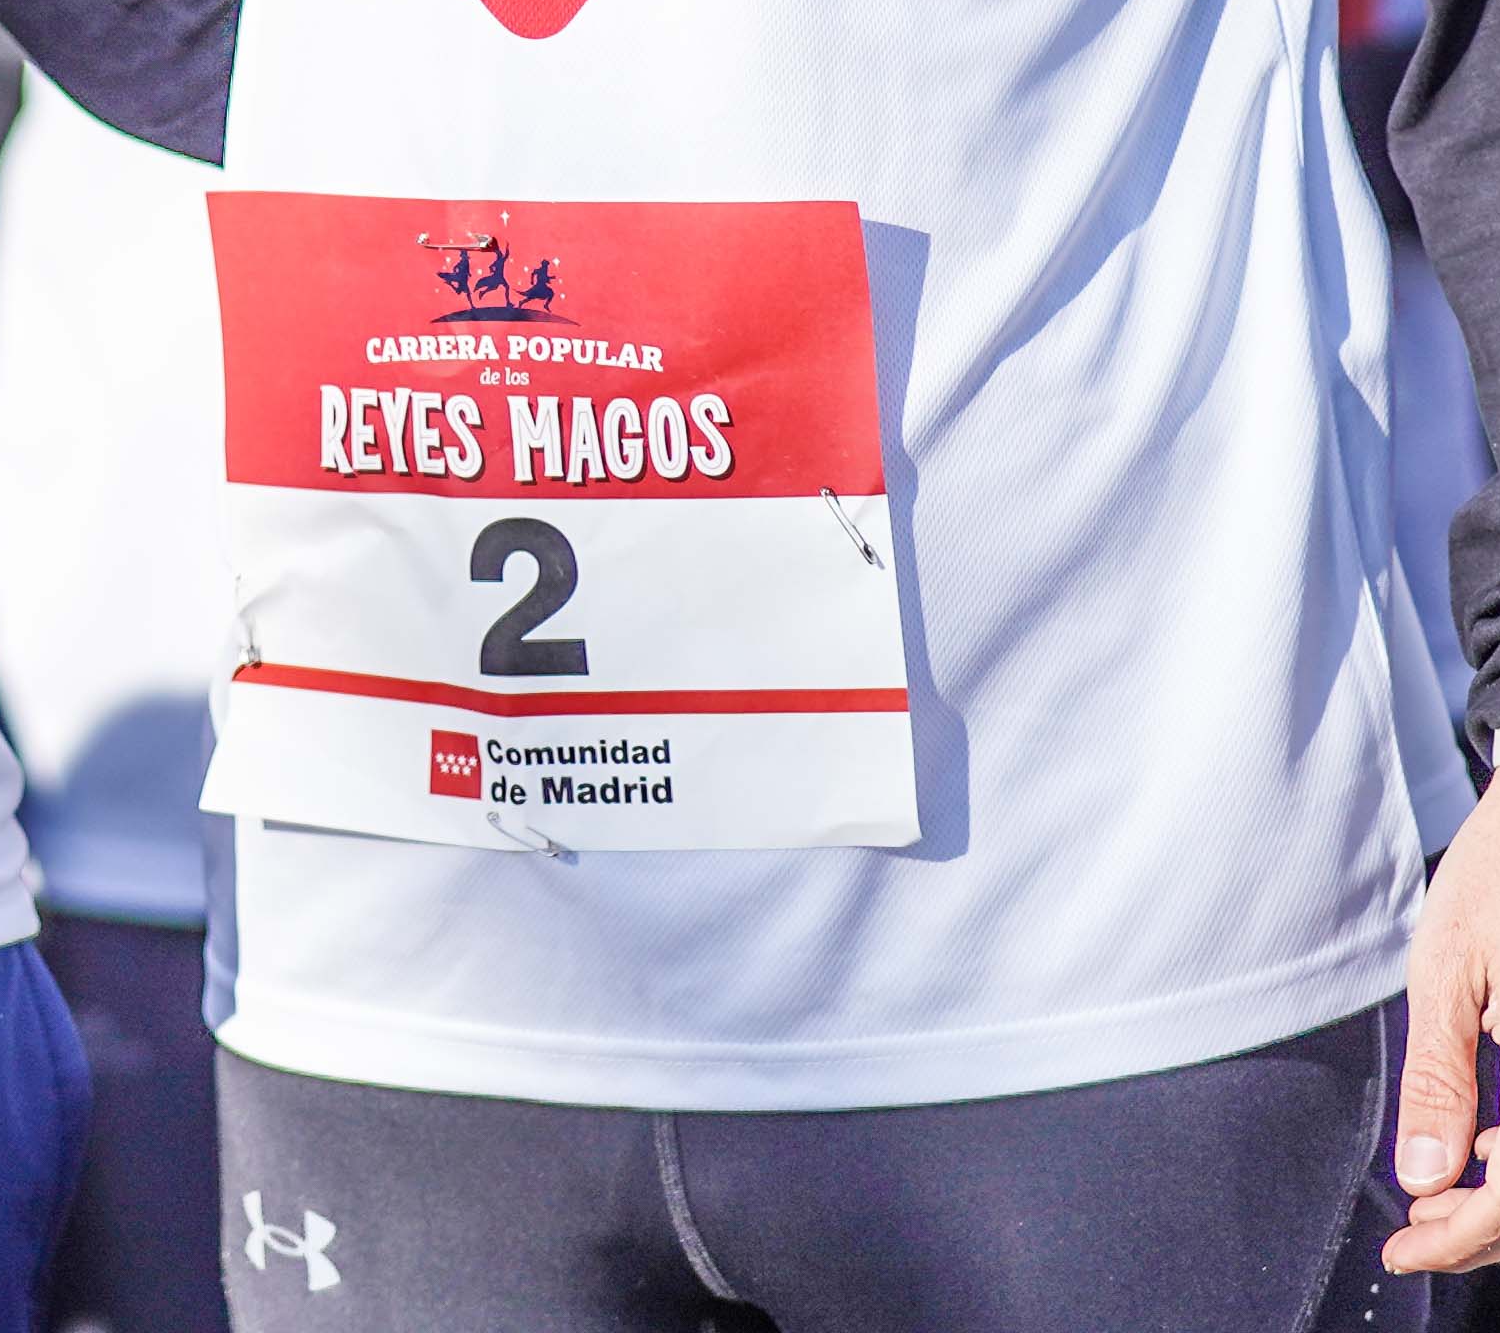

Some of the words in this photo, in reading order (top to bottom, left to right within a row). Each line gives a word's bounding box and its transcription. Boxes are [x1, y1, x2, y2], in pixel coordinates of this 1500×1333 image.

[366, 336, 499, 363] CARRERA
[508, 337, 664, 372] POPULAR
[480, 367, 501, 386] de
[504, 367, 530, 386] los
[320, 384, 484, 479] REYES
[508, 393, 735, 484] MAGOS
[469, 517, 590, 677] 2
[487, 739, 671, 766] Comunidad
[490, 776, 527, 805] de
[541, 775, 674, 806] Madrid
